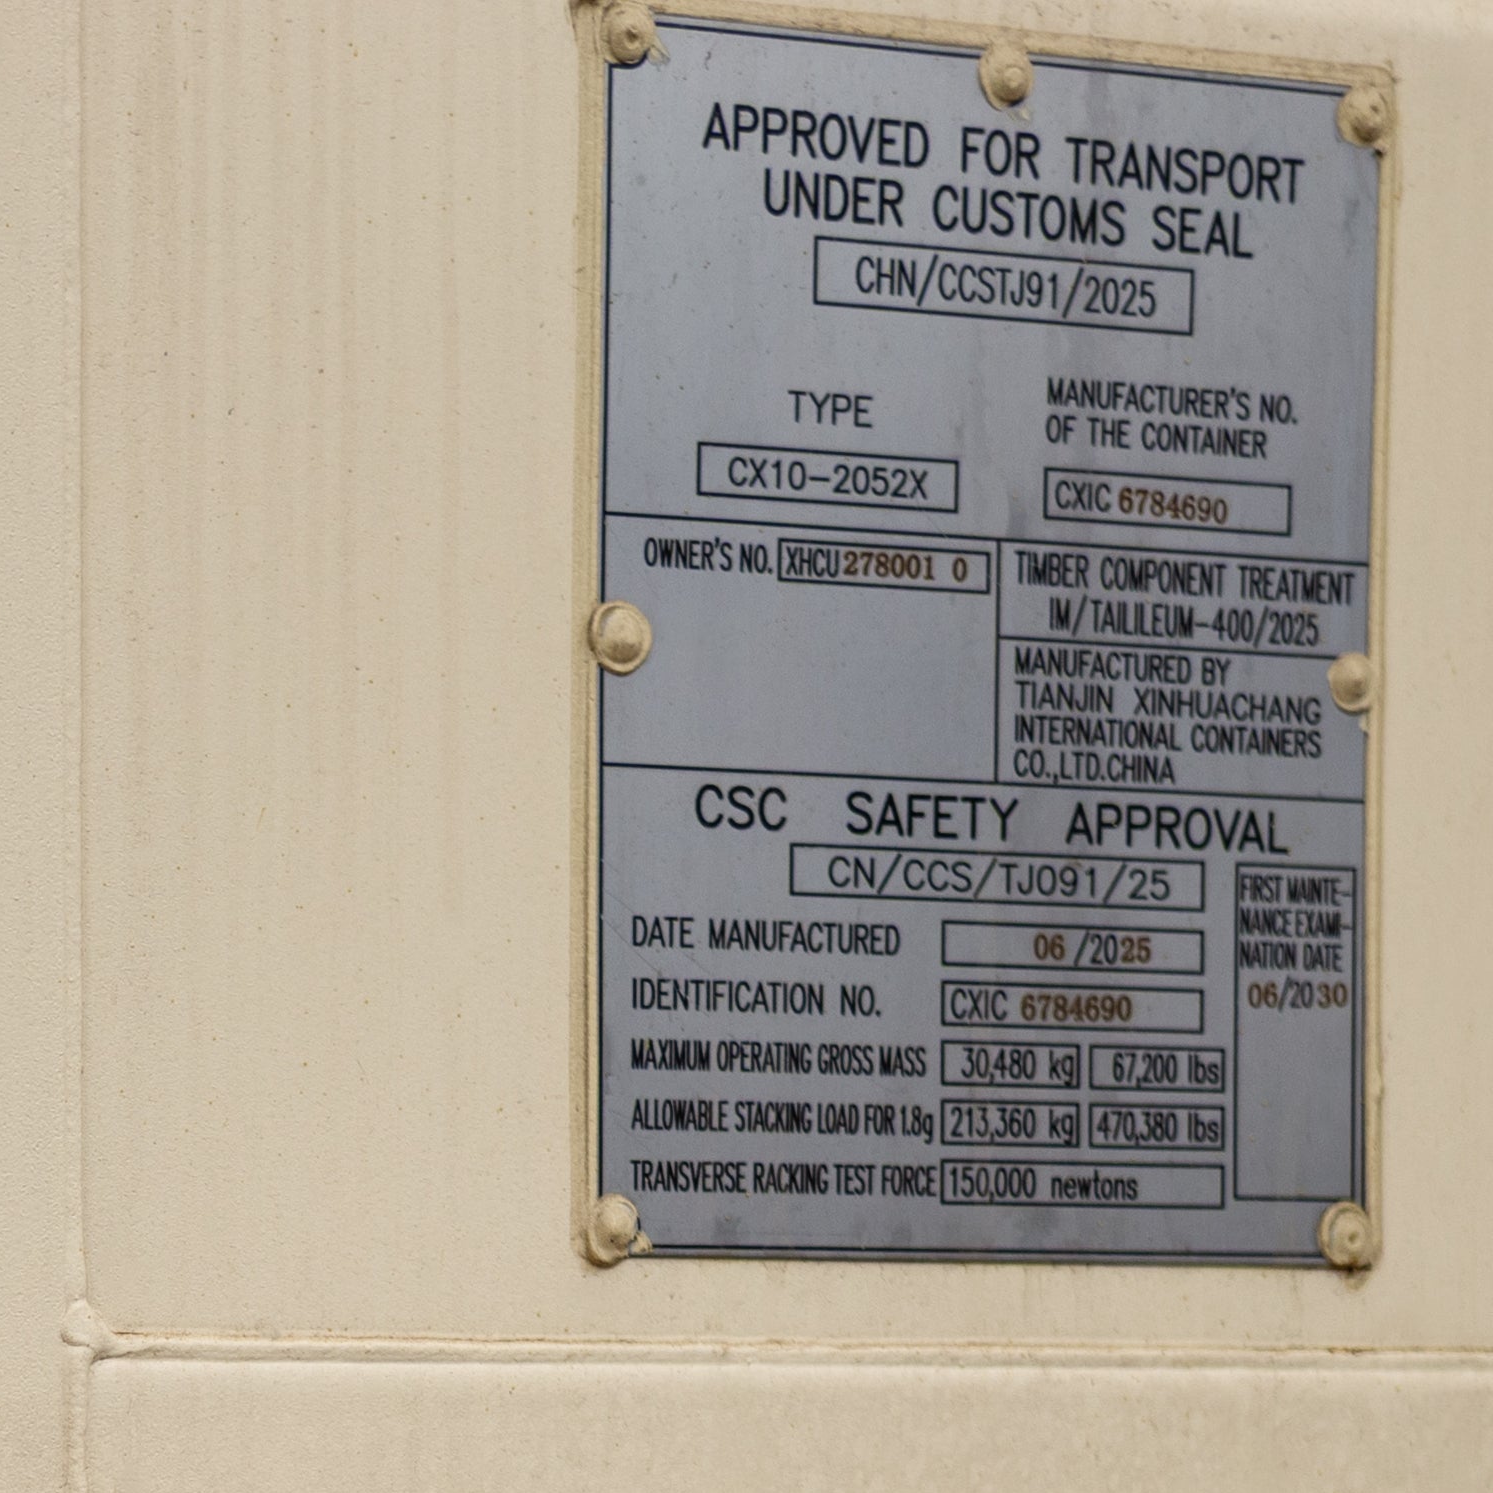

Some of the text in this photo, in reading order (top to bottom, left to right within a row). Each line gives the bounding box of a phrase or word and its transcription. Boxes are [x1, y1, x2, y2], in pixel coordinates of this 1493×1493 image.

[703, 102, 1305, 204] APPROVED FOR TRANSPORT
[764, 168, 1254, 259] UNDER CUSTOMS SEAL
[788, 390, 874, 428] TYPE
[1047, 377, 1297, 426] MANUFACTURER'S NO.
[1045, 414, 1267, 459] OF THE CONTAINER
[728, 457, 928, 499] CX10-2052X
[1055, 480, 1228, 524] CXIC 6784690
[644, 537, 732, 572] OWNER'S
[740, 544, 773, 575] NO.
[1016, 551, 1355, 605] TIMBER COMPONENT TREATMENT
[1014, 647, 1231, 686] MANUFACTURED BY
[1016, 681, 1321, 726] TIANJIN XINHUACHANG
[1015, 715, 1321, 759] INTERNATIONAL CONTAINERS
[695, 783, 1290, 855] CSC SAFETY APPROVAL
[1239, 874, 1352, 907] FIRST MAINTE-
[632, 915, 901, 956] DATE MANUFACTURED
[1239, 907, 1353, 938] NANCE EXAMI-
[1239, 941, 1343, 974] NATION DATE
[632, 977, 881, 1018] IDENTIFICATION NO.
[950, 987, 1133, 1023] CXIC 6784690
[631, 1038, 927, 1077] MAXIMUM OPERATING GROSS MASS
[961, 1047, 1075, 1086] 30,480 kg
[1112, 1053, 1220, 1088] 67,200 lbs
[631, 1099, 934, 1145] ALLOWABLE STACKING LOAD FOR 1.8g
[950, 1106, 1075, 1145] 213,360 kg
[1097, 1110, 1220, 1146] 470,380 lbs
[630, 1160, 937, 1198] TRANSVERSE RACKING TEST FORCE
[949, 1166, 1138, 1203] 150,000 newtons
